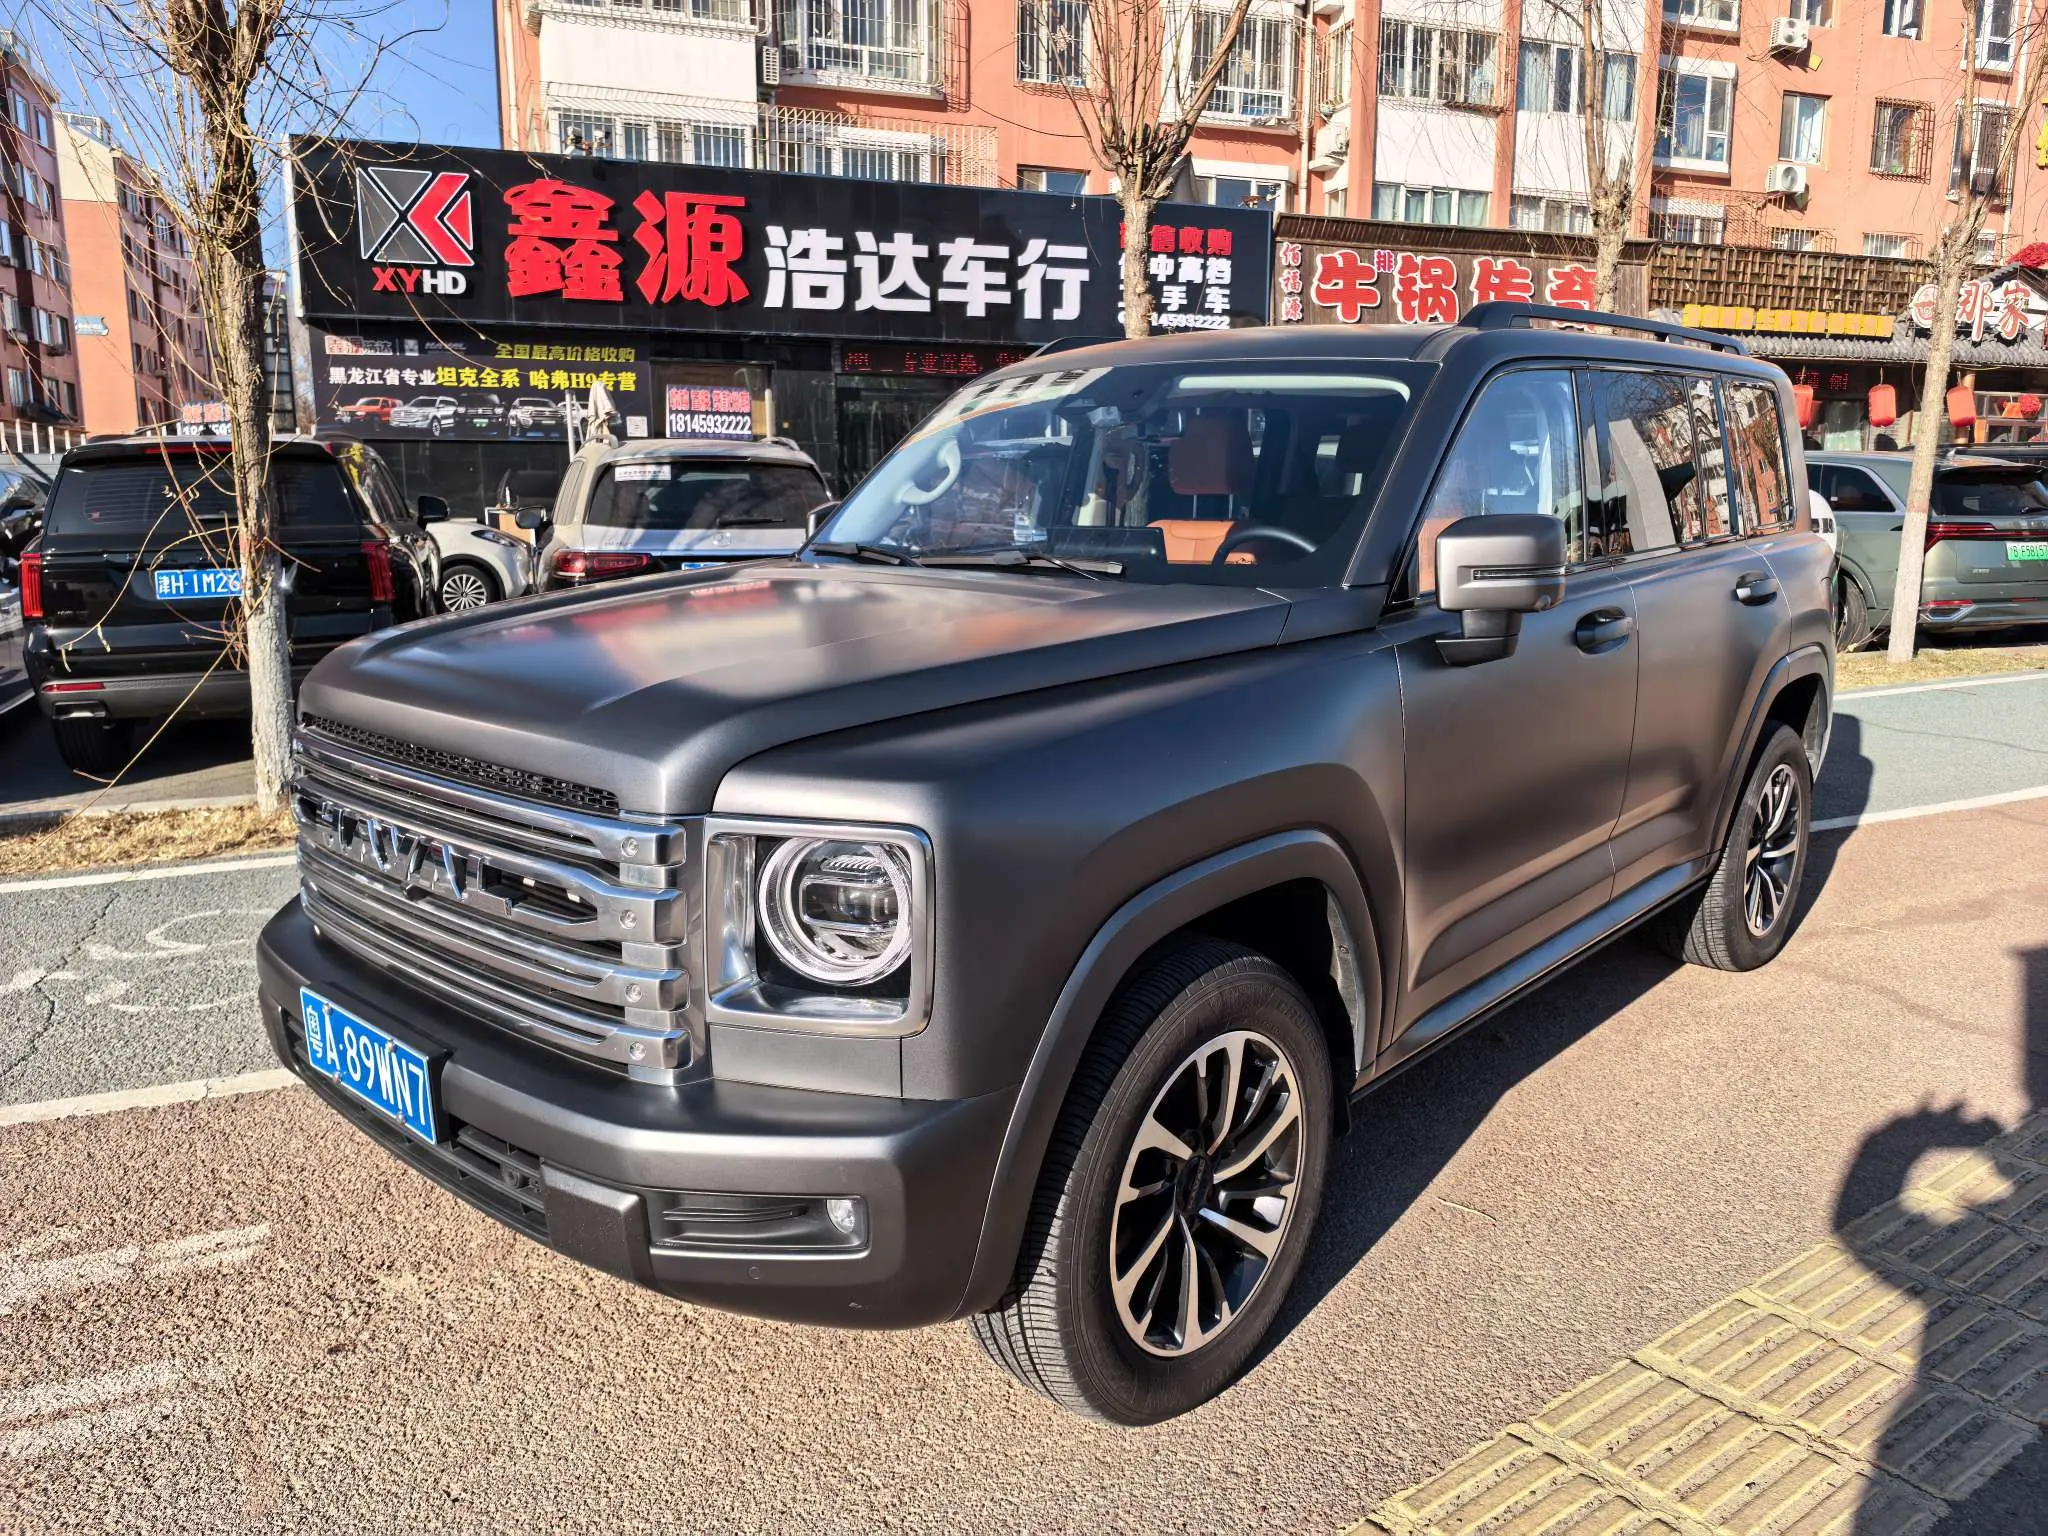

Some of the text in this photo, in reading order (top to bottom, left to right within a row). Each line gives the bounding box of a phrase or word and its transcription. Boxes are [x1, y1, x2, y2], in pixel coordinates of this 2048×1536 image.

[503, 178, 1090, 321] 鑫源 浩达车行
[1119, 222, 1232, 255] 信收购
[372, 267, 467, 295] XYHD
[1118, 252, 1232, 284] 中高档
[1118, 284, 1231, 314] 手车
[495, 343, 636, 363] 全国最高价格收购
[669, 413, 752, 434] 18145932222
